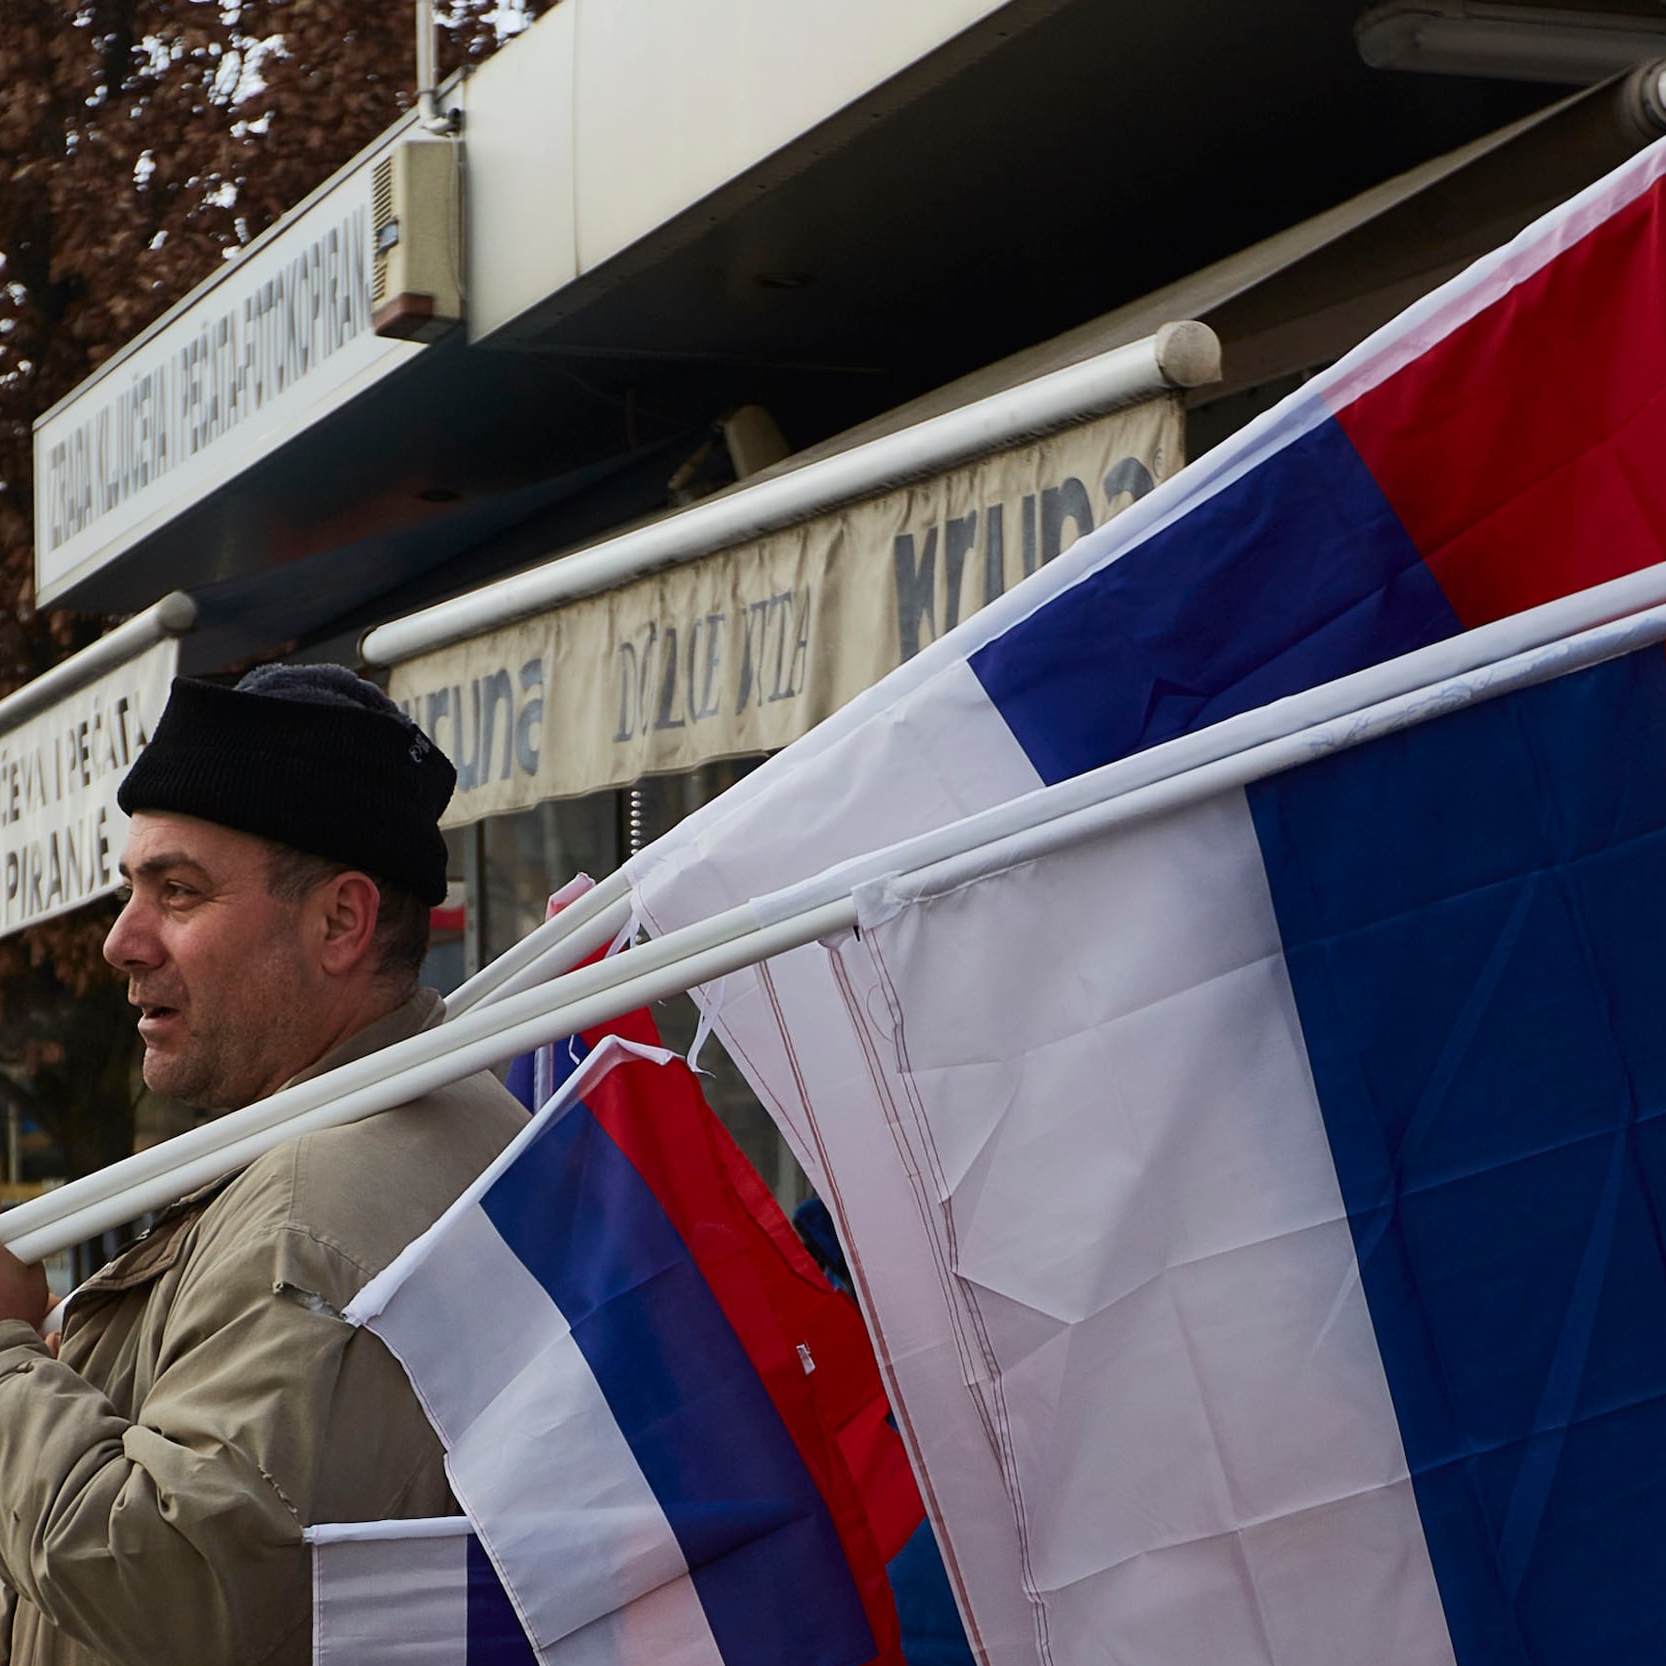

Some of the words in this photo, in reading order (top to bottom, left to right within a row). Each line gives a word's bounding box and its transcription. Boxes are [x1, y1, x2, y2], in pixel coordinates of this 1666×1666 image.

[400, 657, 544, 793] runa
[735, 584, 811, 716] VITA
[54, 736, 62, 801] I
